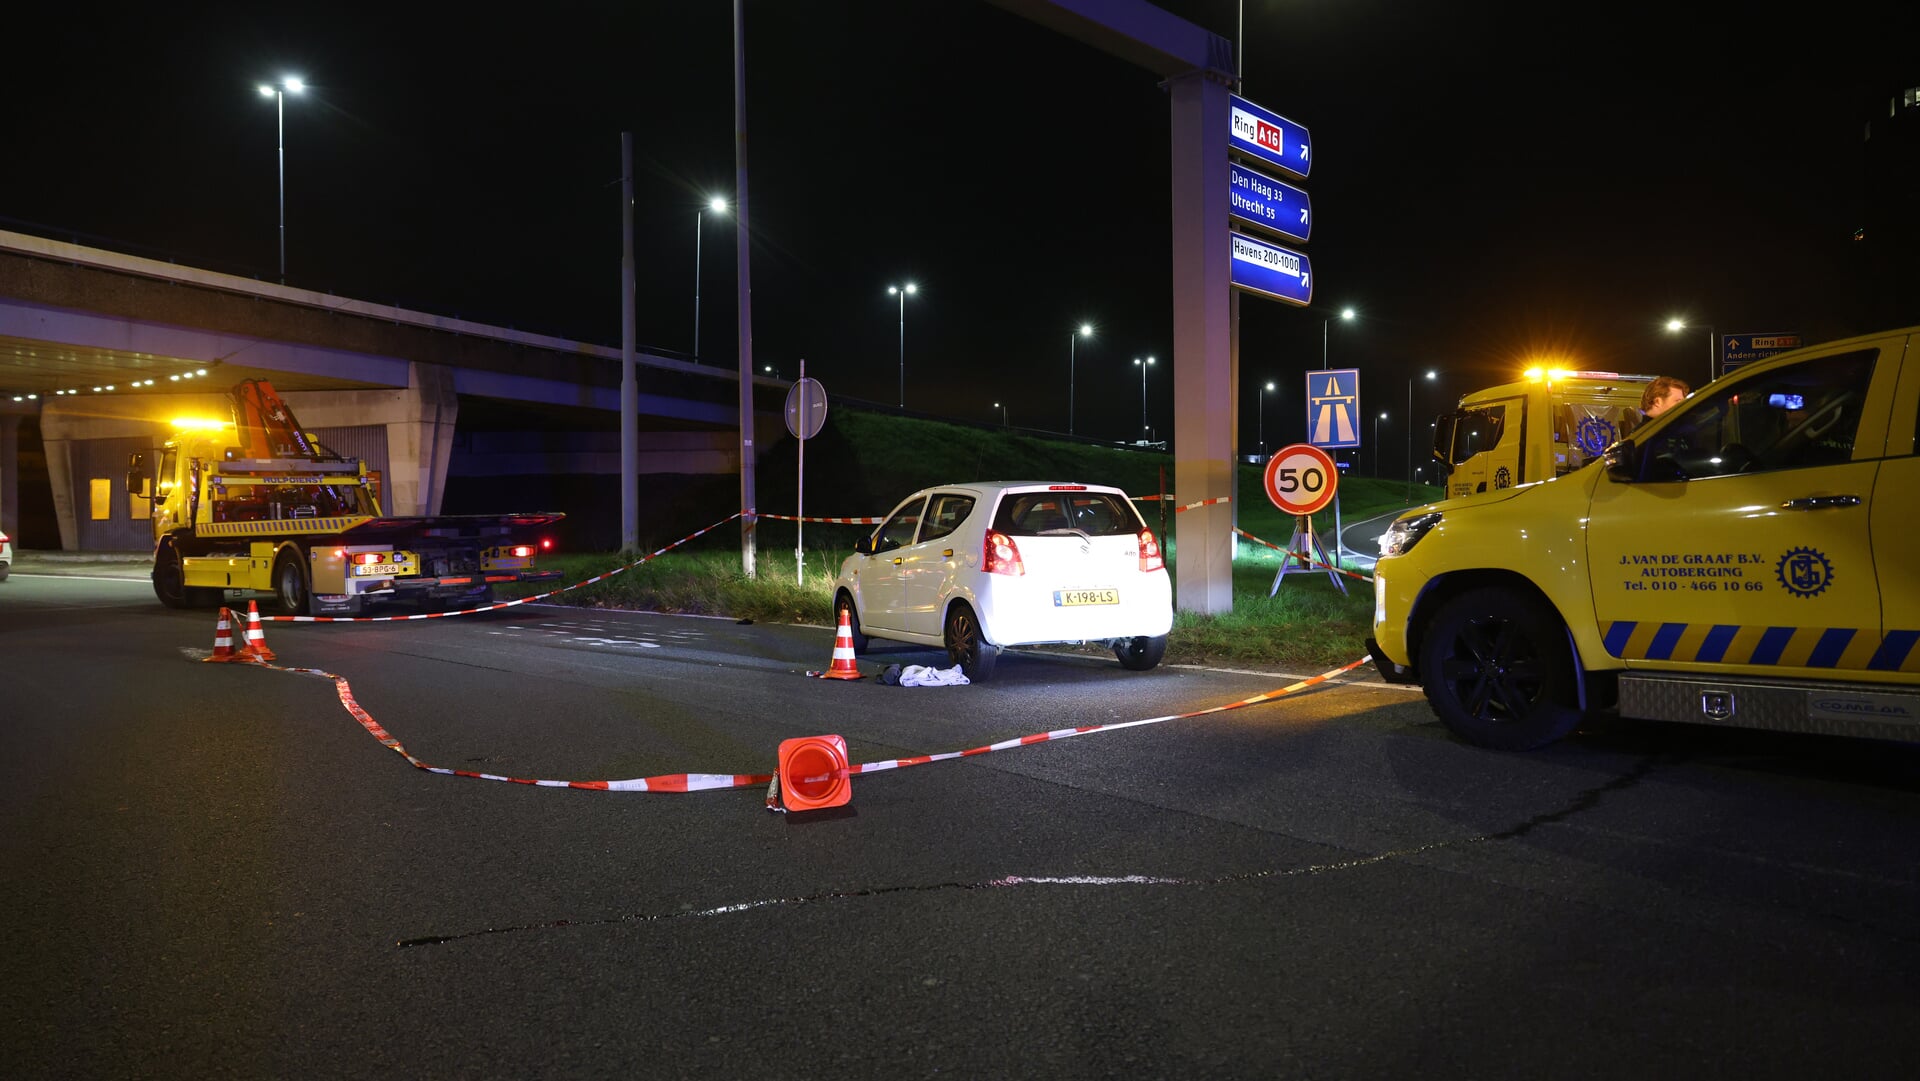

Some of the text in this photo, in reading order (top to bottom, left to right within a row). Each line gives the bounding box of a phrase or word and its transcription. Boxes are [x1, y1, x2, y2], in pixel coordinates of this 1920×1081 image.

[1233, 114, 1279, 148] Ring A16
[1232, 170, 1283, 202] Den Haag 33
[1232, 191, 1276, 220] Utrecht 55
[1234, 240, 1299, 272] Havens 200-1000
[1755, 339, 1775, 347] Ring
[1727, 352, 1757, 360] Andere
[1279, 468, 1323, 493] 50
[1661, 554, 1680, 564] DE
[1683, 553, 1733, 564] GRAAF
[1738, 554, 1765, 564] B.V.
[1641, 567, 1743, 578] AUTOBERGING
[1624, 580, 1648, 591] Tel.
[1652, 581, 1677, 591] 010
[1691, 581, 1717, 591] 466
[1723, 581, 1741, 591] 10
[1744, 581, 1763, 591] 66
[1065, 591, 1113, 604] K-198-LS
